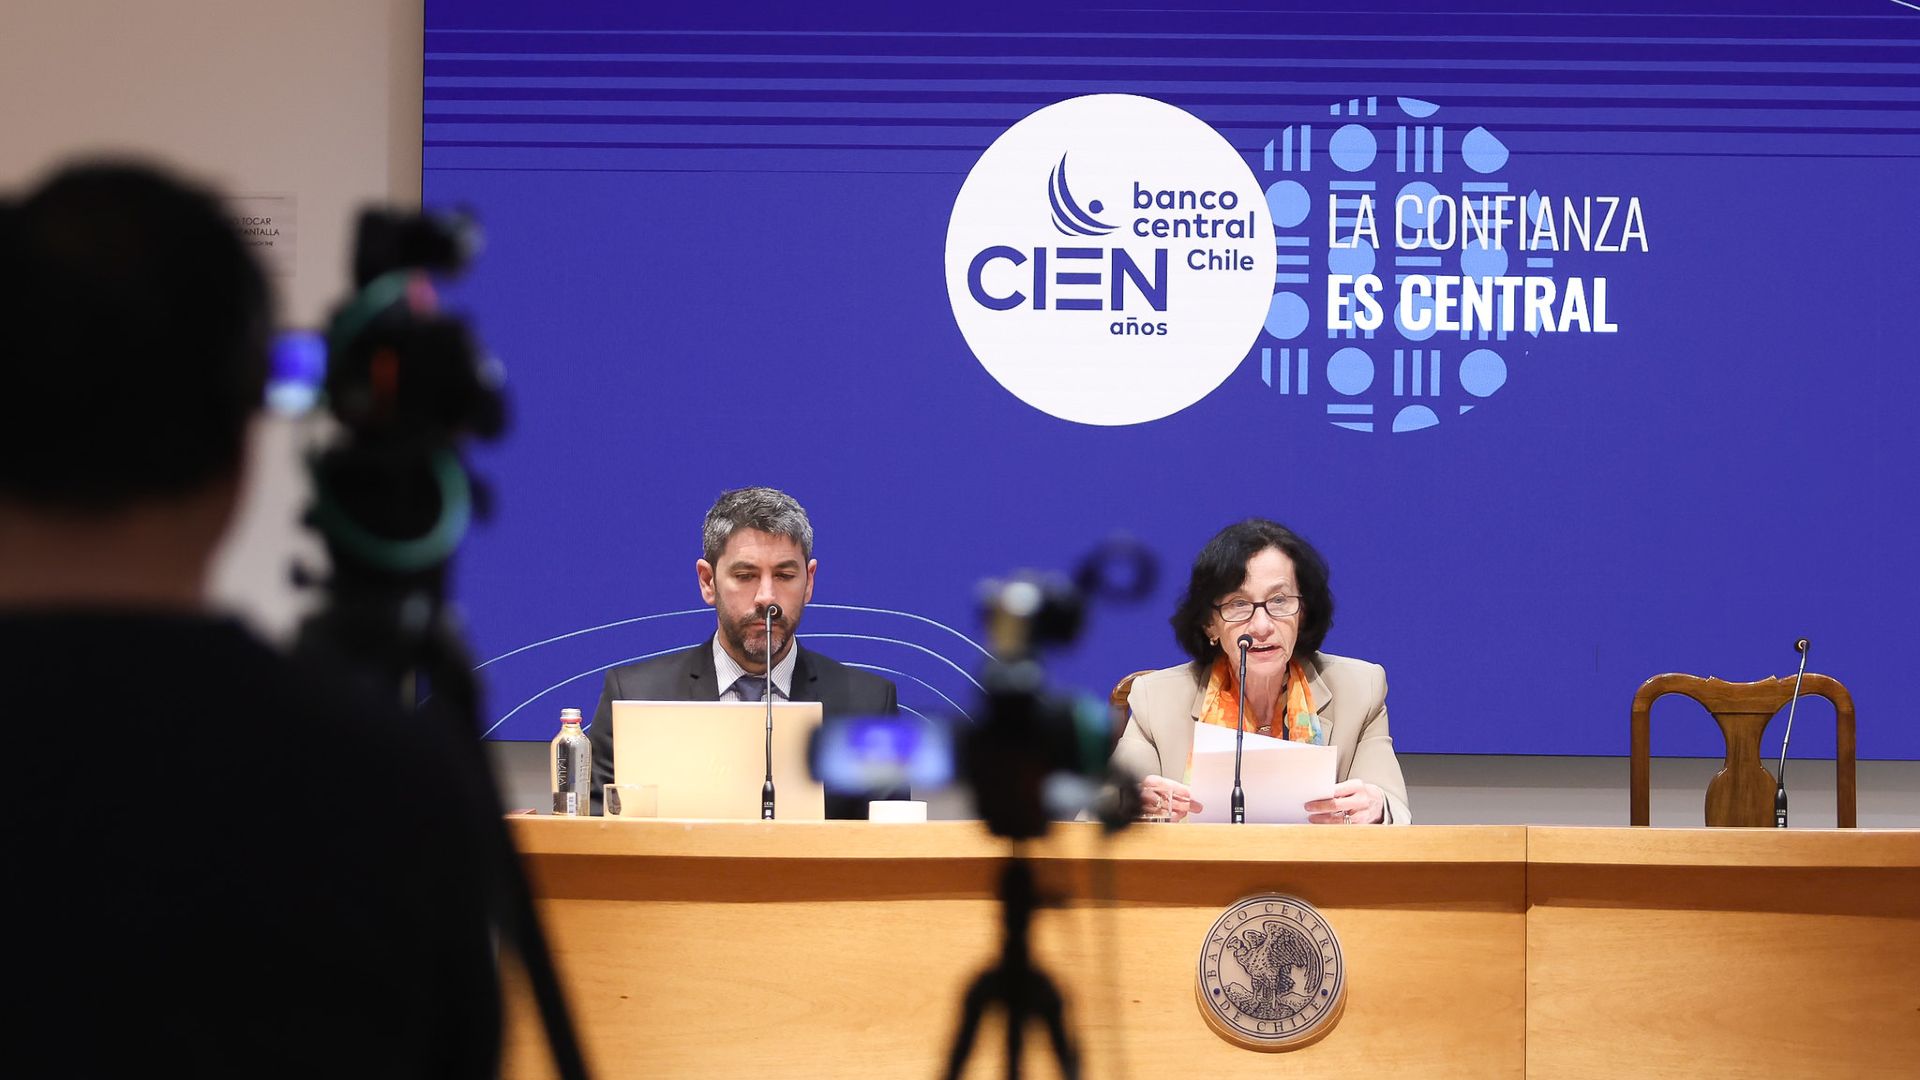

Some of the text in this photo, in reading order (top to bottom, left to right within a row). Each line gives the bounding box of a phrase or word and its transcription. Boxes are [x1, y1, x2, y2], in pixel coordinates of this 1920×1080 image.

[1133, 181, 1239, 210] banco
[1133, 211, 1255, 238] central
[1328, 194, 1649, 252] LA CONFIANZA
[1187, 249, 1254, 271] Chile
[967, 245, 1168, 312] CIEN
[1327, 274, 1618, 333] ES CENTRAL
[1109, 317, 1168, 336] años
[1207, 903, 1335, 980] BANCO CENTRAL
[1219, 1000, 1321, 1032] DE CHILE
